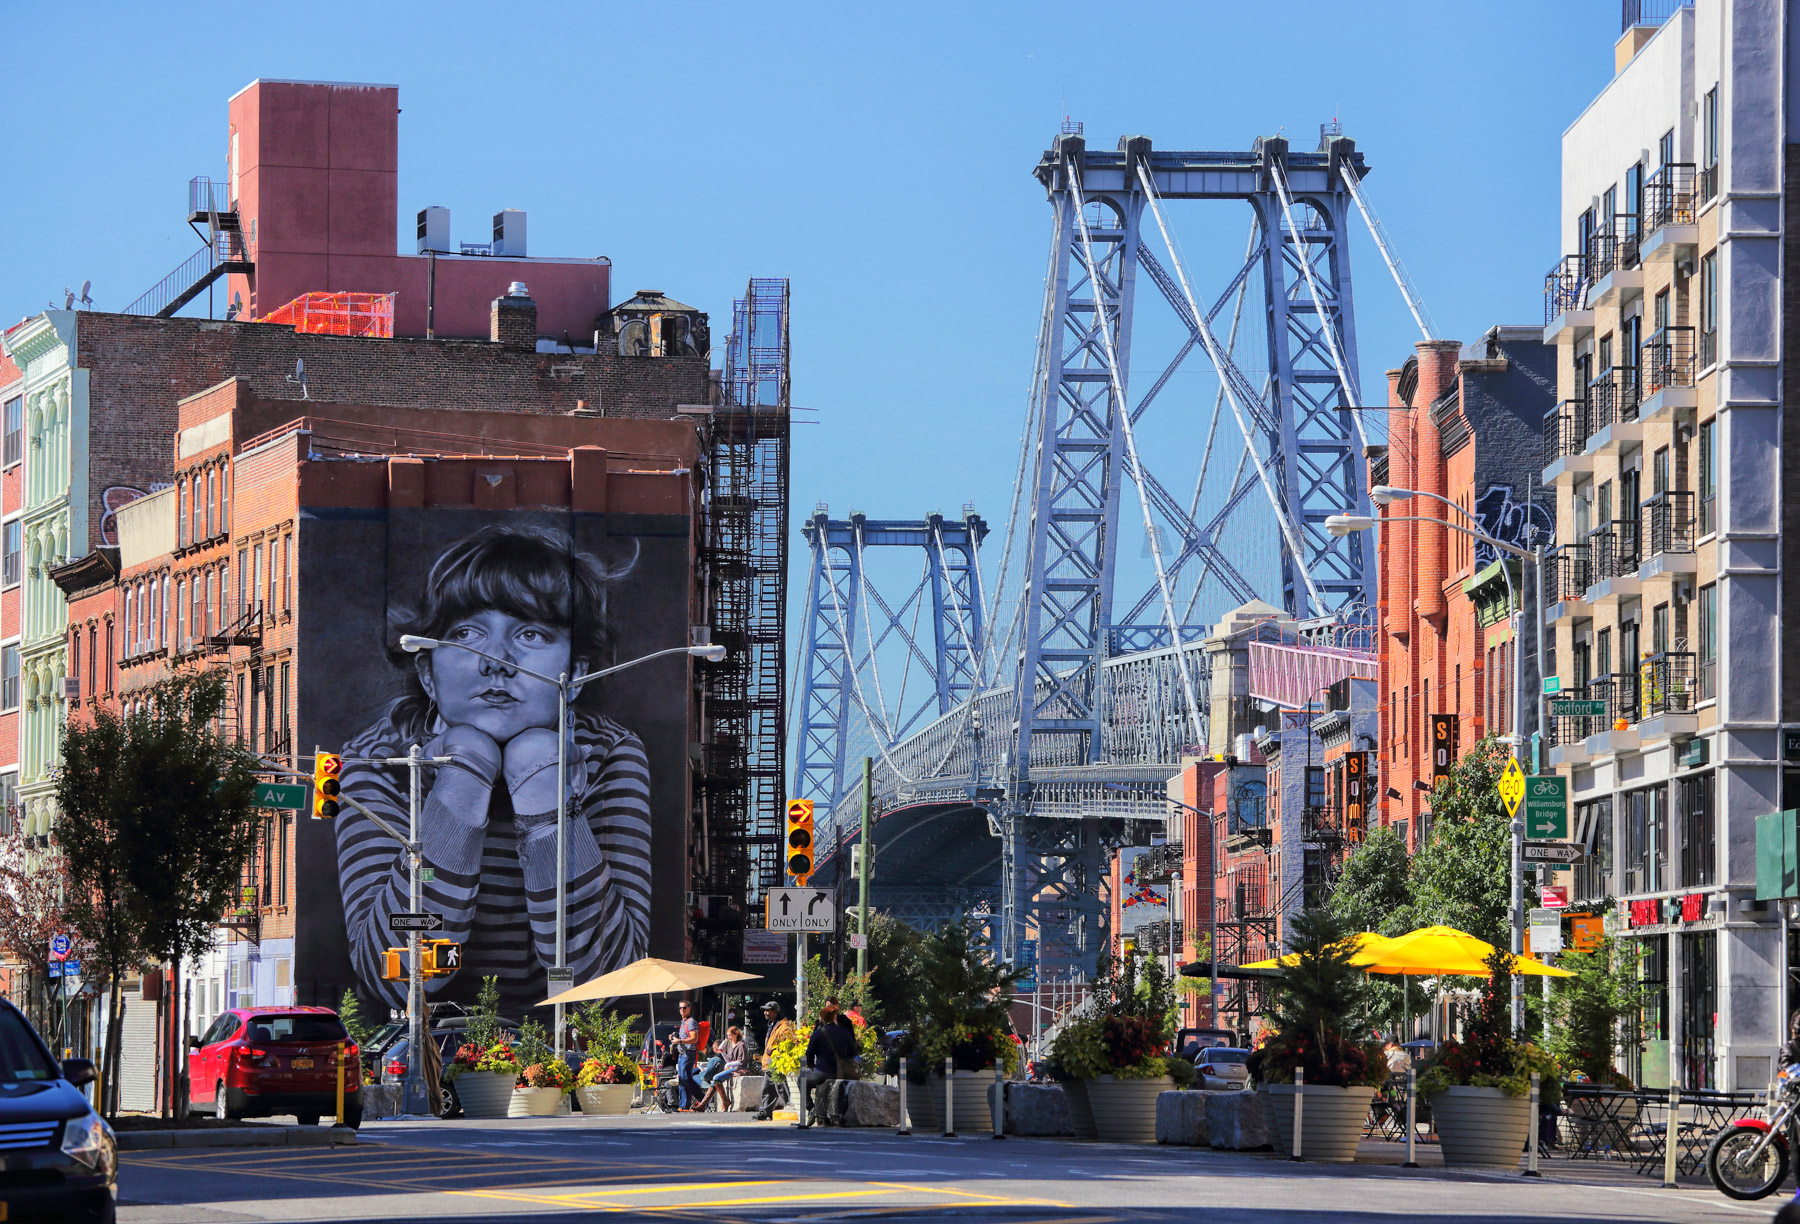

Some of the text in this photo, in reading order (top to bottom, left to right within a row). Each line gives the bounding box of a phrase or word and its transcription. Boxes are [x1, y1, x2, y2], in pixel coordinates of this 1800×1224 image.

[1552, 702, 1592, 715] Bedford
[264, 789, 286, 803] Av
[1527, 801, 1566, 809] Williamsburg
[1535, 811, 1558, 819] Bridge
[1530, 848, 1576, 858] ONE WAY
[393, 918, 437, 926] ONE WAY
[772, 918, 798, 927] ONLY
[804, 918, 830, 927] ONLY
